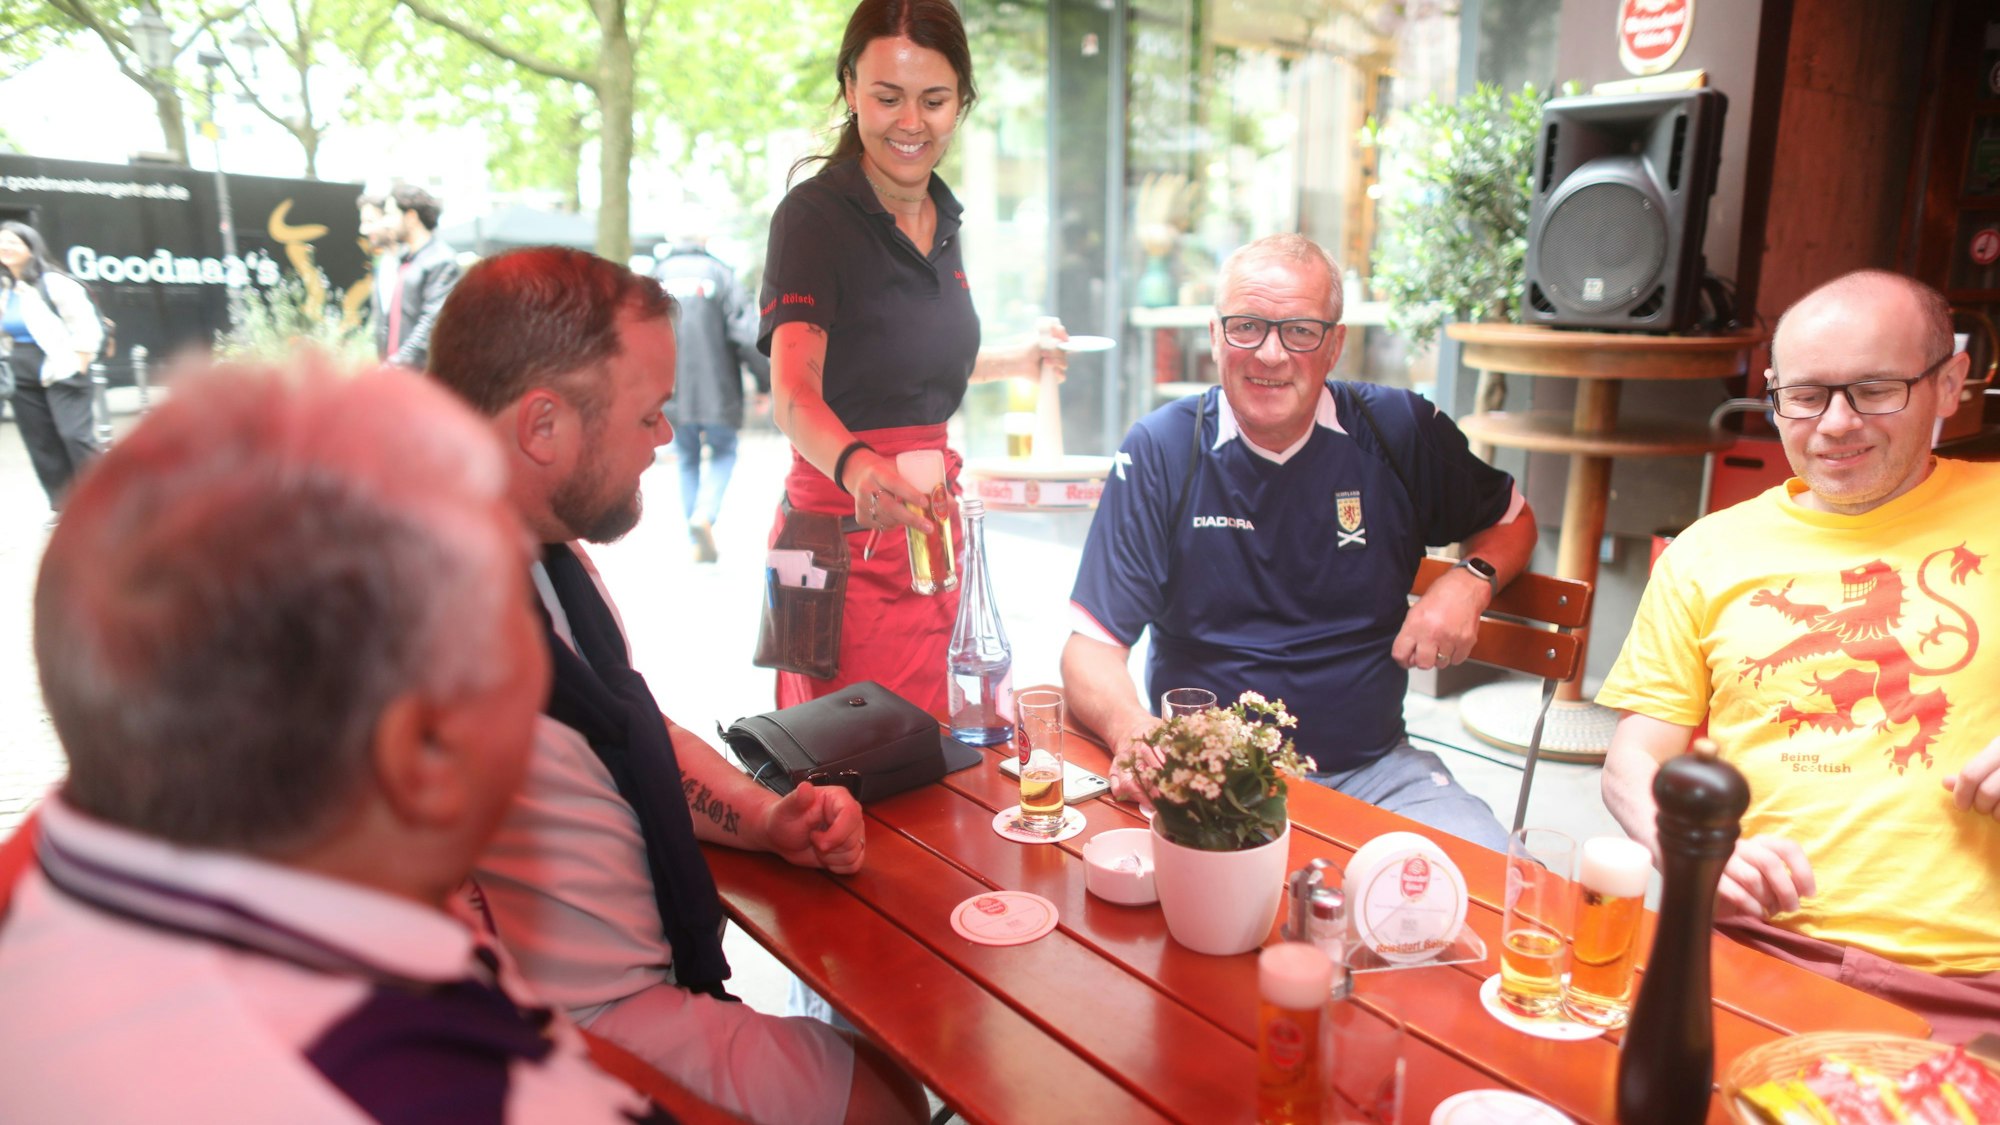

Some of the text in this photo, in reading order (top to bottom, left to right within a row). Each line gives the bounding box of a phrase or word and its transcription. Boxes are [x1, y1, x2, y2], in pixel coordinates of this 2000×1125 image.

[1193, 516, 1255, 530] DIADORA
[1780, 752, 1820, 764] Being
[1792, 763, 1852, 773] Scottish
